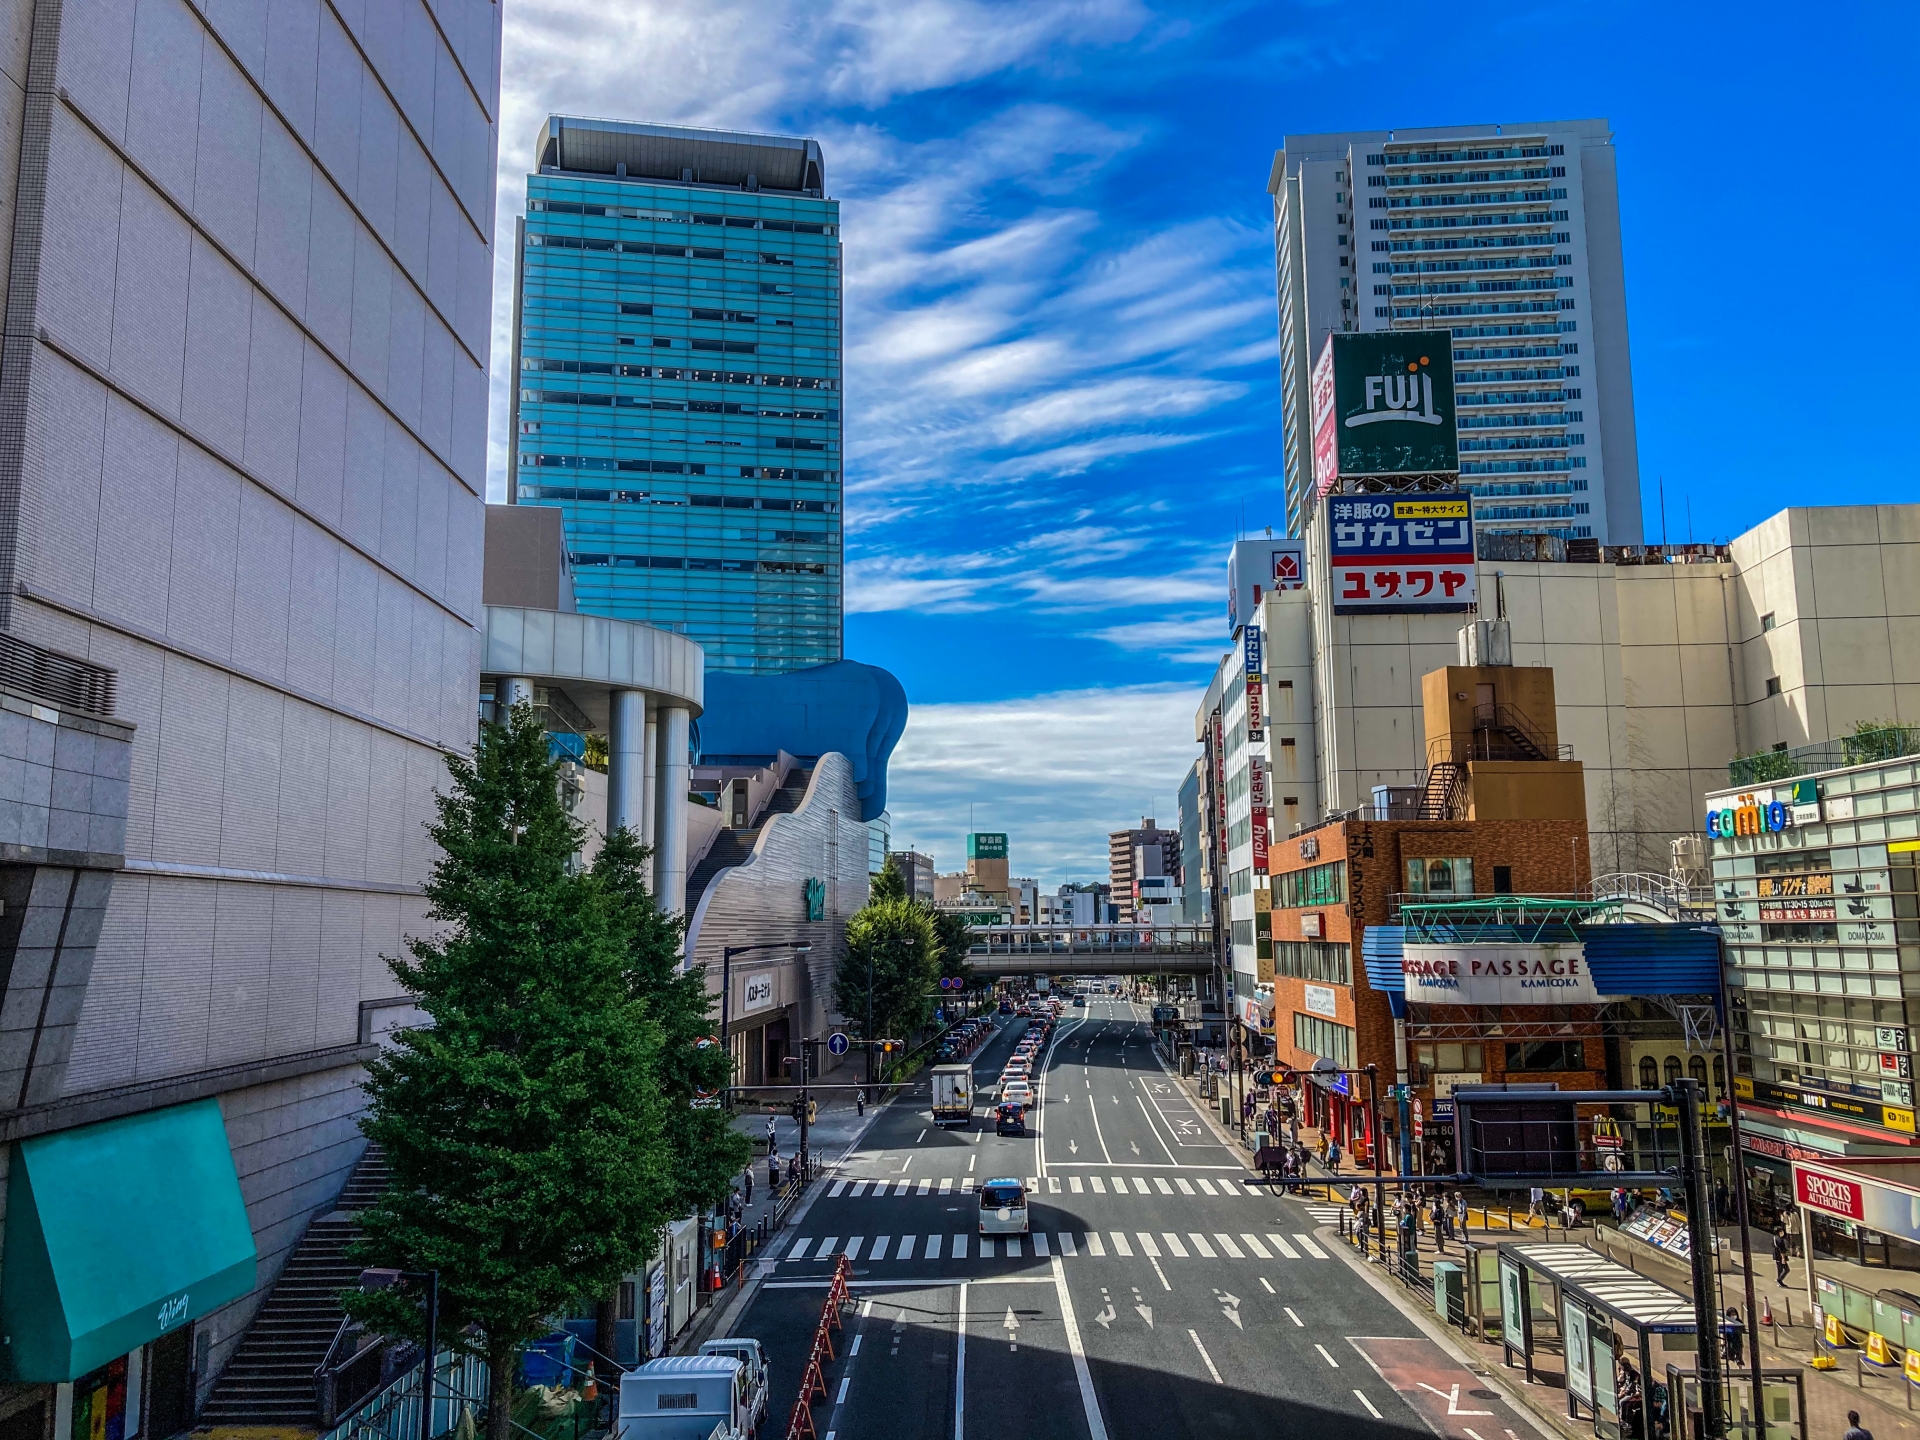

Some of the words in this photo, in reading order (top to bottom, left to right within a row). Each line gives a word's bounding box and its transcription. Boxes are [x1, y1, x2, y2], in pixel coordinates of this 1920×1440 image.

[1360, 370, 1437, 420] FUJI
[1334, 502, 1391, 520] 洋服の
[1334, 520, 1469, 547] サカゼン
[1342, 570, 1467, 599] ユザワヤ
[1246, 628, 1260, 673] サカゼン
[1251, 731, 1262, 741] 3F
[1251, 760, 1264, 804] しまむら
[1705, 795, 1785, 839] camio
[1253, 824, 1268, 859] Avail
[1360, 822, 1376, 859] 上大岡
[1256, 867, 1267, 875] 1F
[1471, 959, 1580, 976] PASSAGE
[1521, 978, 1579, 988] KAMIOOKA
[1441, 1125, 1454, 1136] 80
[1806, 1174, 1851, 1203] SPORTS
[1808, 1192, 1852, 1214] AUTHORITY
[158, 1293, 190, 1331] Wing
